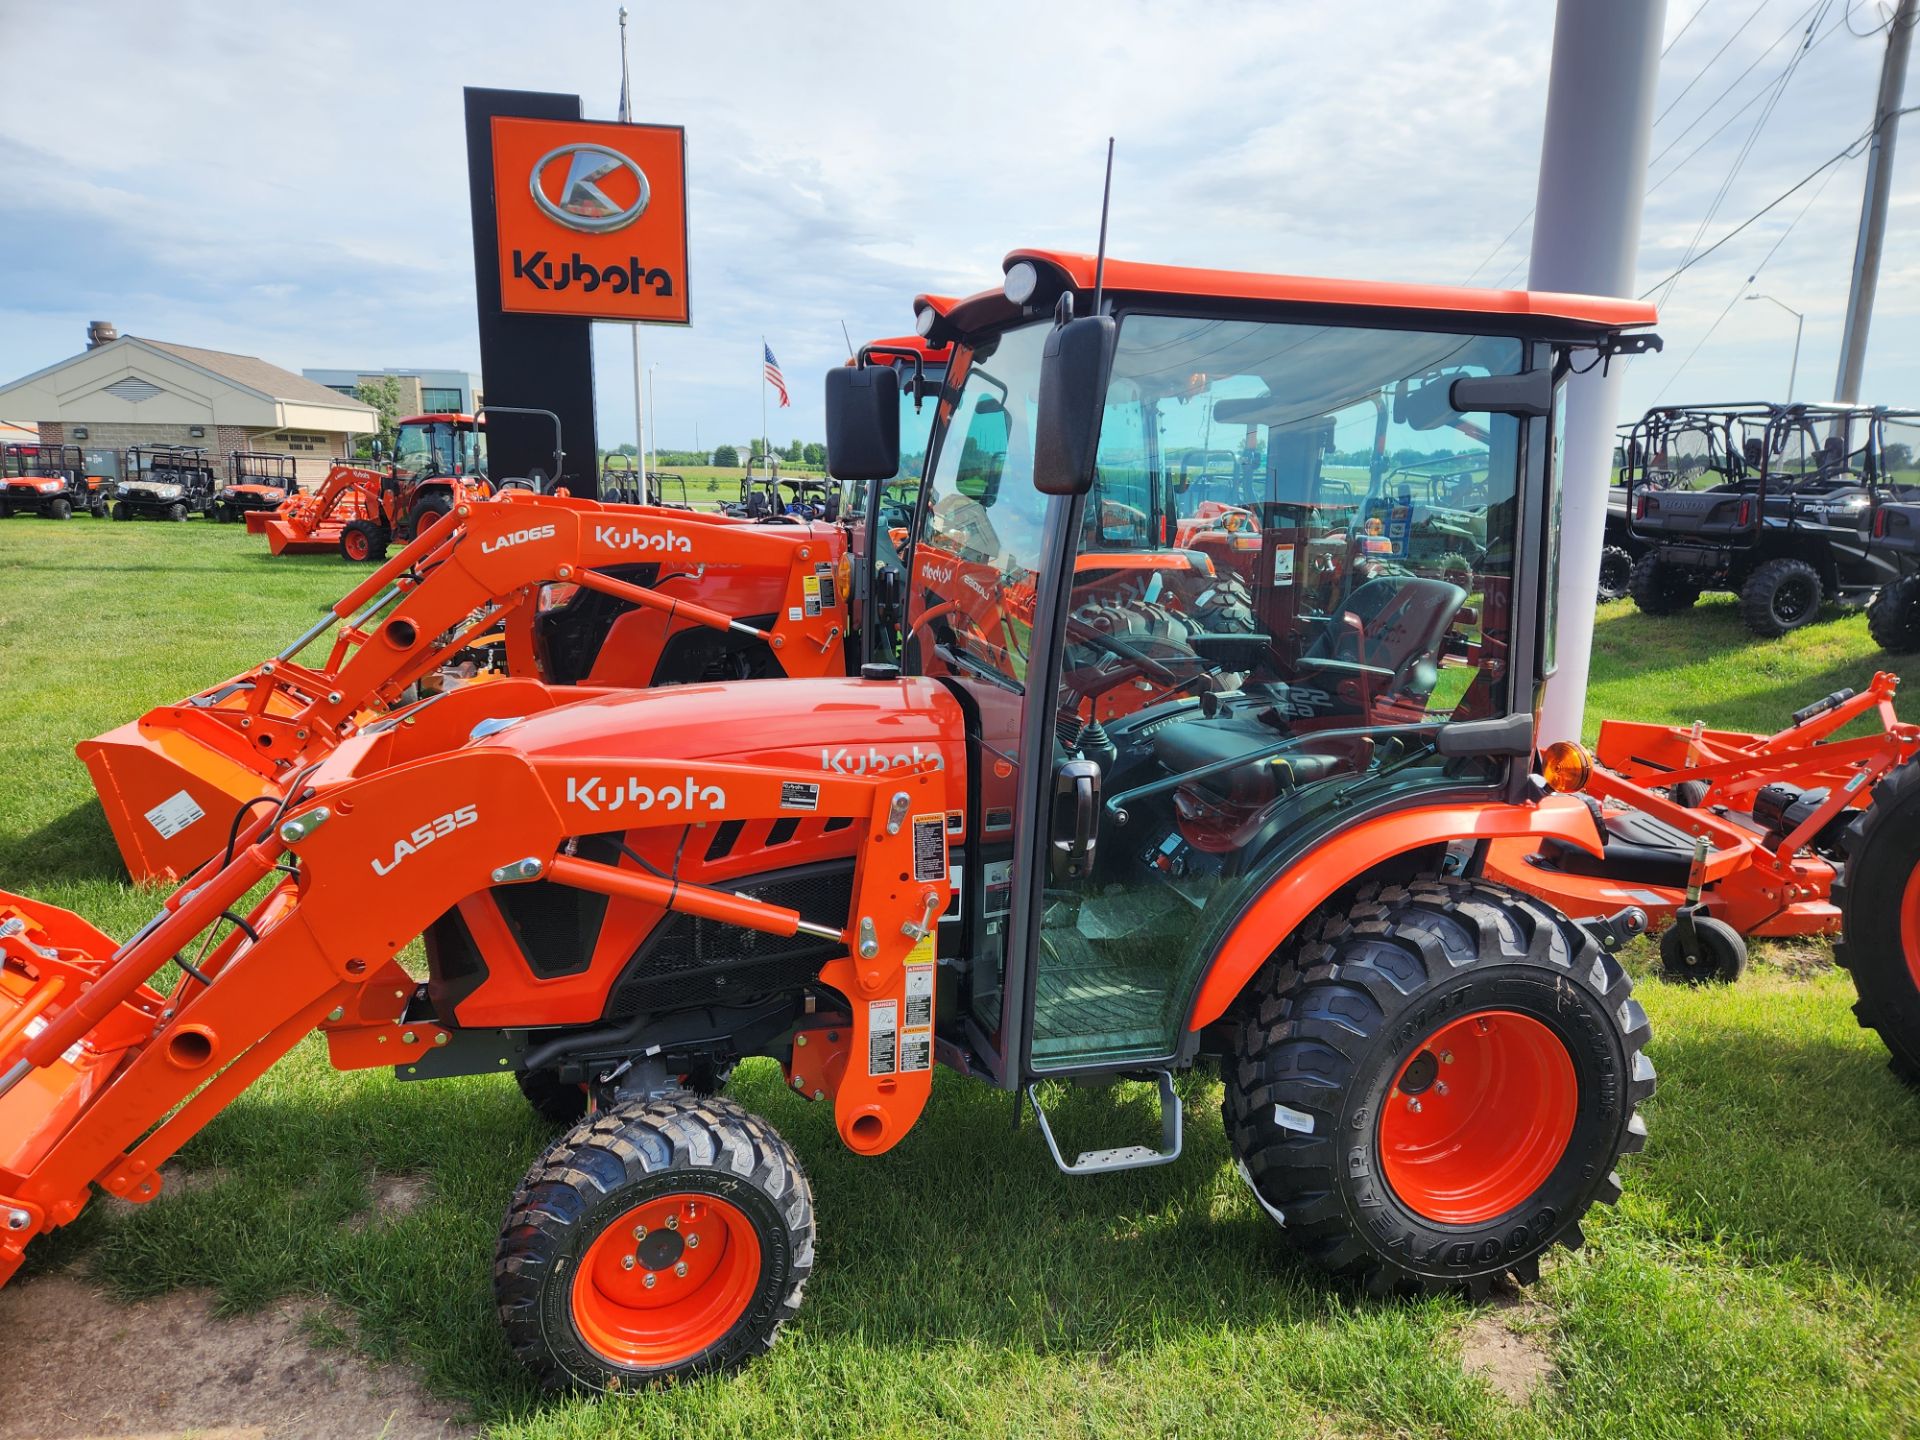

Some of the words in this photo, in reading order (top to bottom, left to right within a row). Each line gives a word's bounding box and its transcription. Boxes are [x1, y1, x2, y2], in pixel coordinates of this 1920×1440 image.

[513, 250, 672, 296] Kubota
[481, 524, 555, 554] LA1065
[595, 525, 691, 552] Kubota
[822, 746, 944, 775] Kubota
[567, 776, 726, 811] Kubota
[370, 804, 478, 877] LA535
[1348, 1145, 1556, 1268] GOODYEAR
